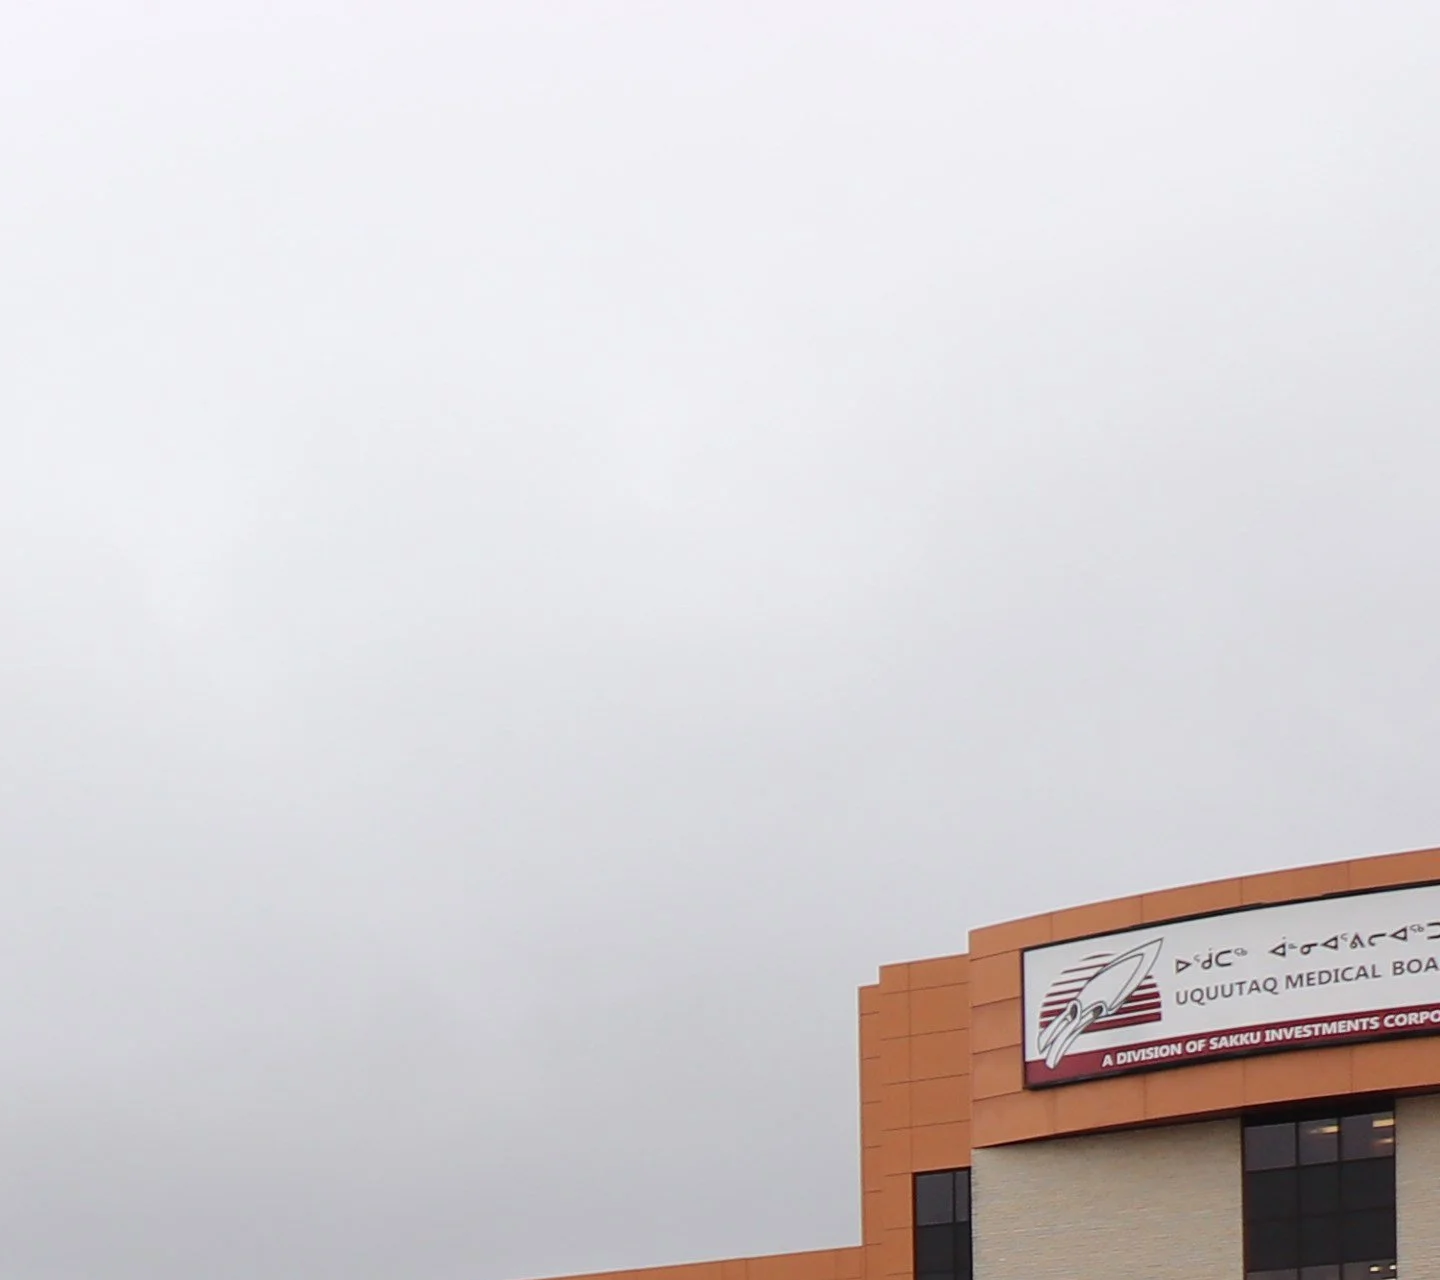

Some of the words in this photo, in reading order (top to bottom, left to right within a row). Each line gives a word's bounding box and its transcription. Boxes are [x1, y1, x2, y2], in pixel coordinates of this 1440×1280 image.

[1175, 976, 1279, 1005] UQUUTAQ
[1284, 963, 1382, 990] MEDICAL
[1101, 1055, 1114, 1068] A
[1116, 1042, 1182, 1066] DIVISION
[1185, 1040, 1207, 1054] OF
[1209, 1030, 1262, 1051] SAKKU
[1264, 1016, 1380, 1043] INVESTMENTS
